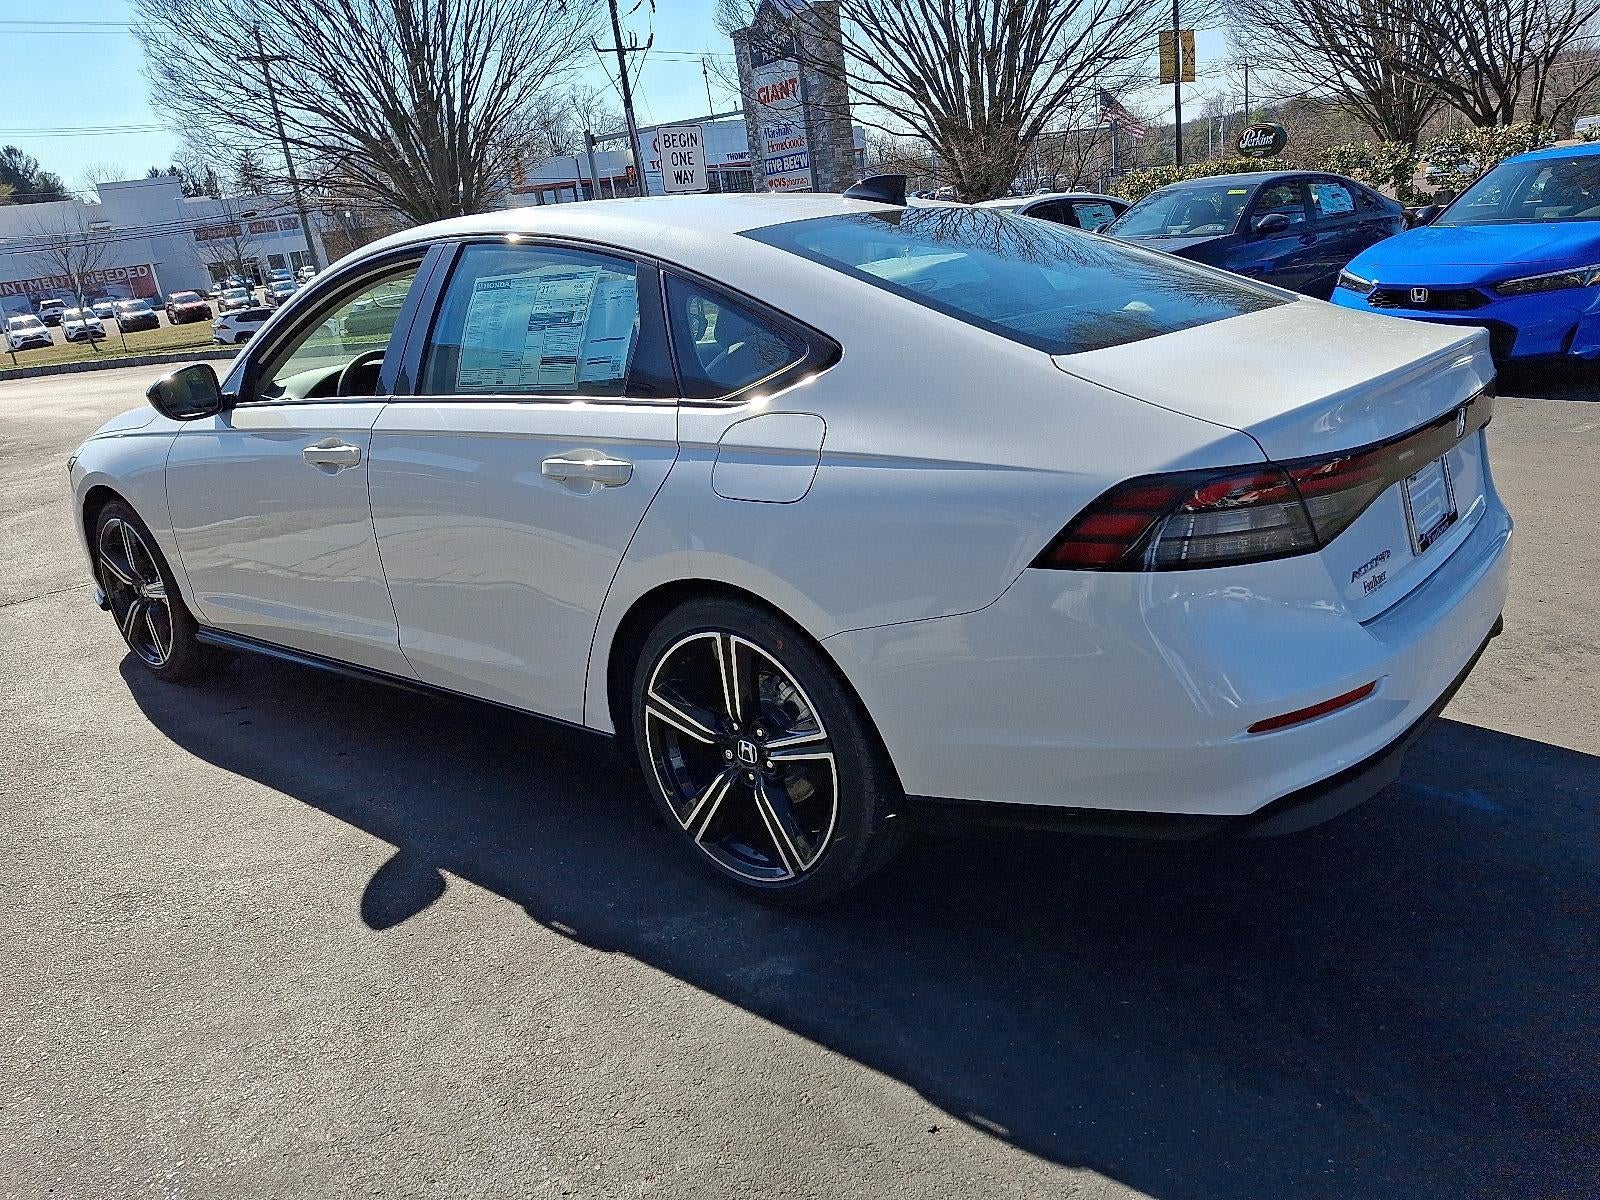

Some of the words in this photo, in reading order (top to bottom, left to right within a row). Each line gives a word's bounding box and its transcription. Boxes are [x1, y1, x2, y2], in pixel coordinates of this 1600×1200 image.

[758, 78, 797, 104] GIANT
[663, 132, 698, 148] BEGIN
[767, 136, 805, 153] HomeGoods
[1240, 129, 1274, 148] Perkins
[671, 151, 695, 167] ONE
[673, 170, 695, 185] WAY
[773, 178, 787, 188] CVS
[84, 265, 149, 286] NEEDED
